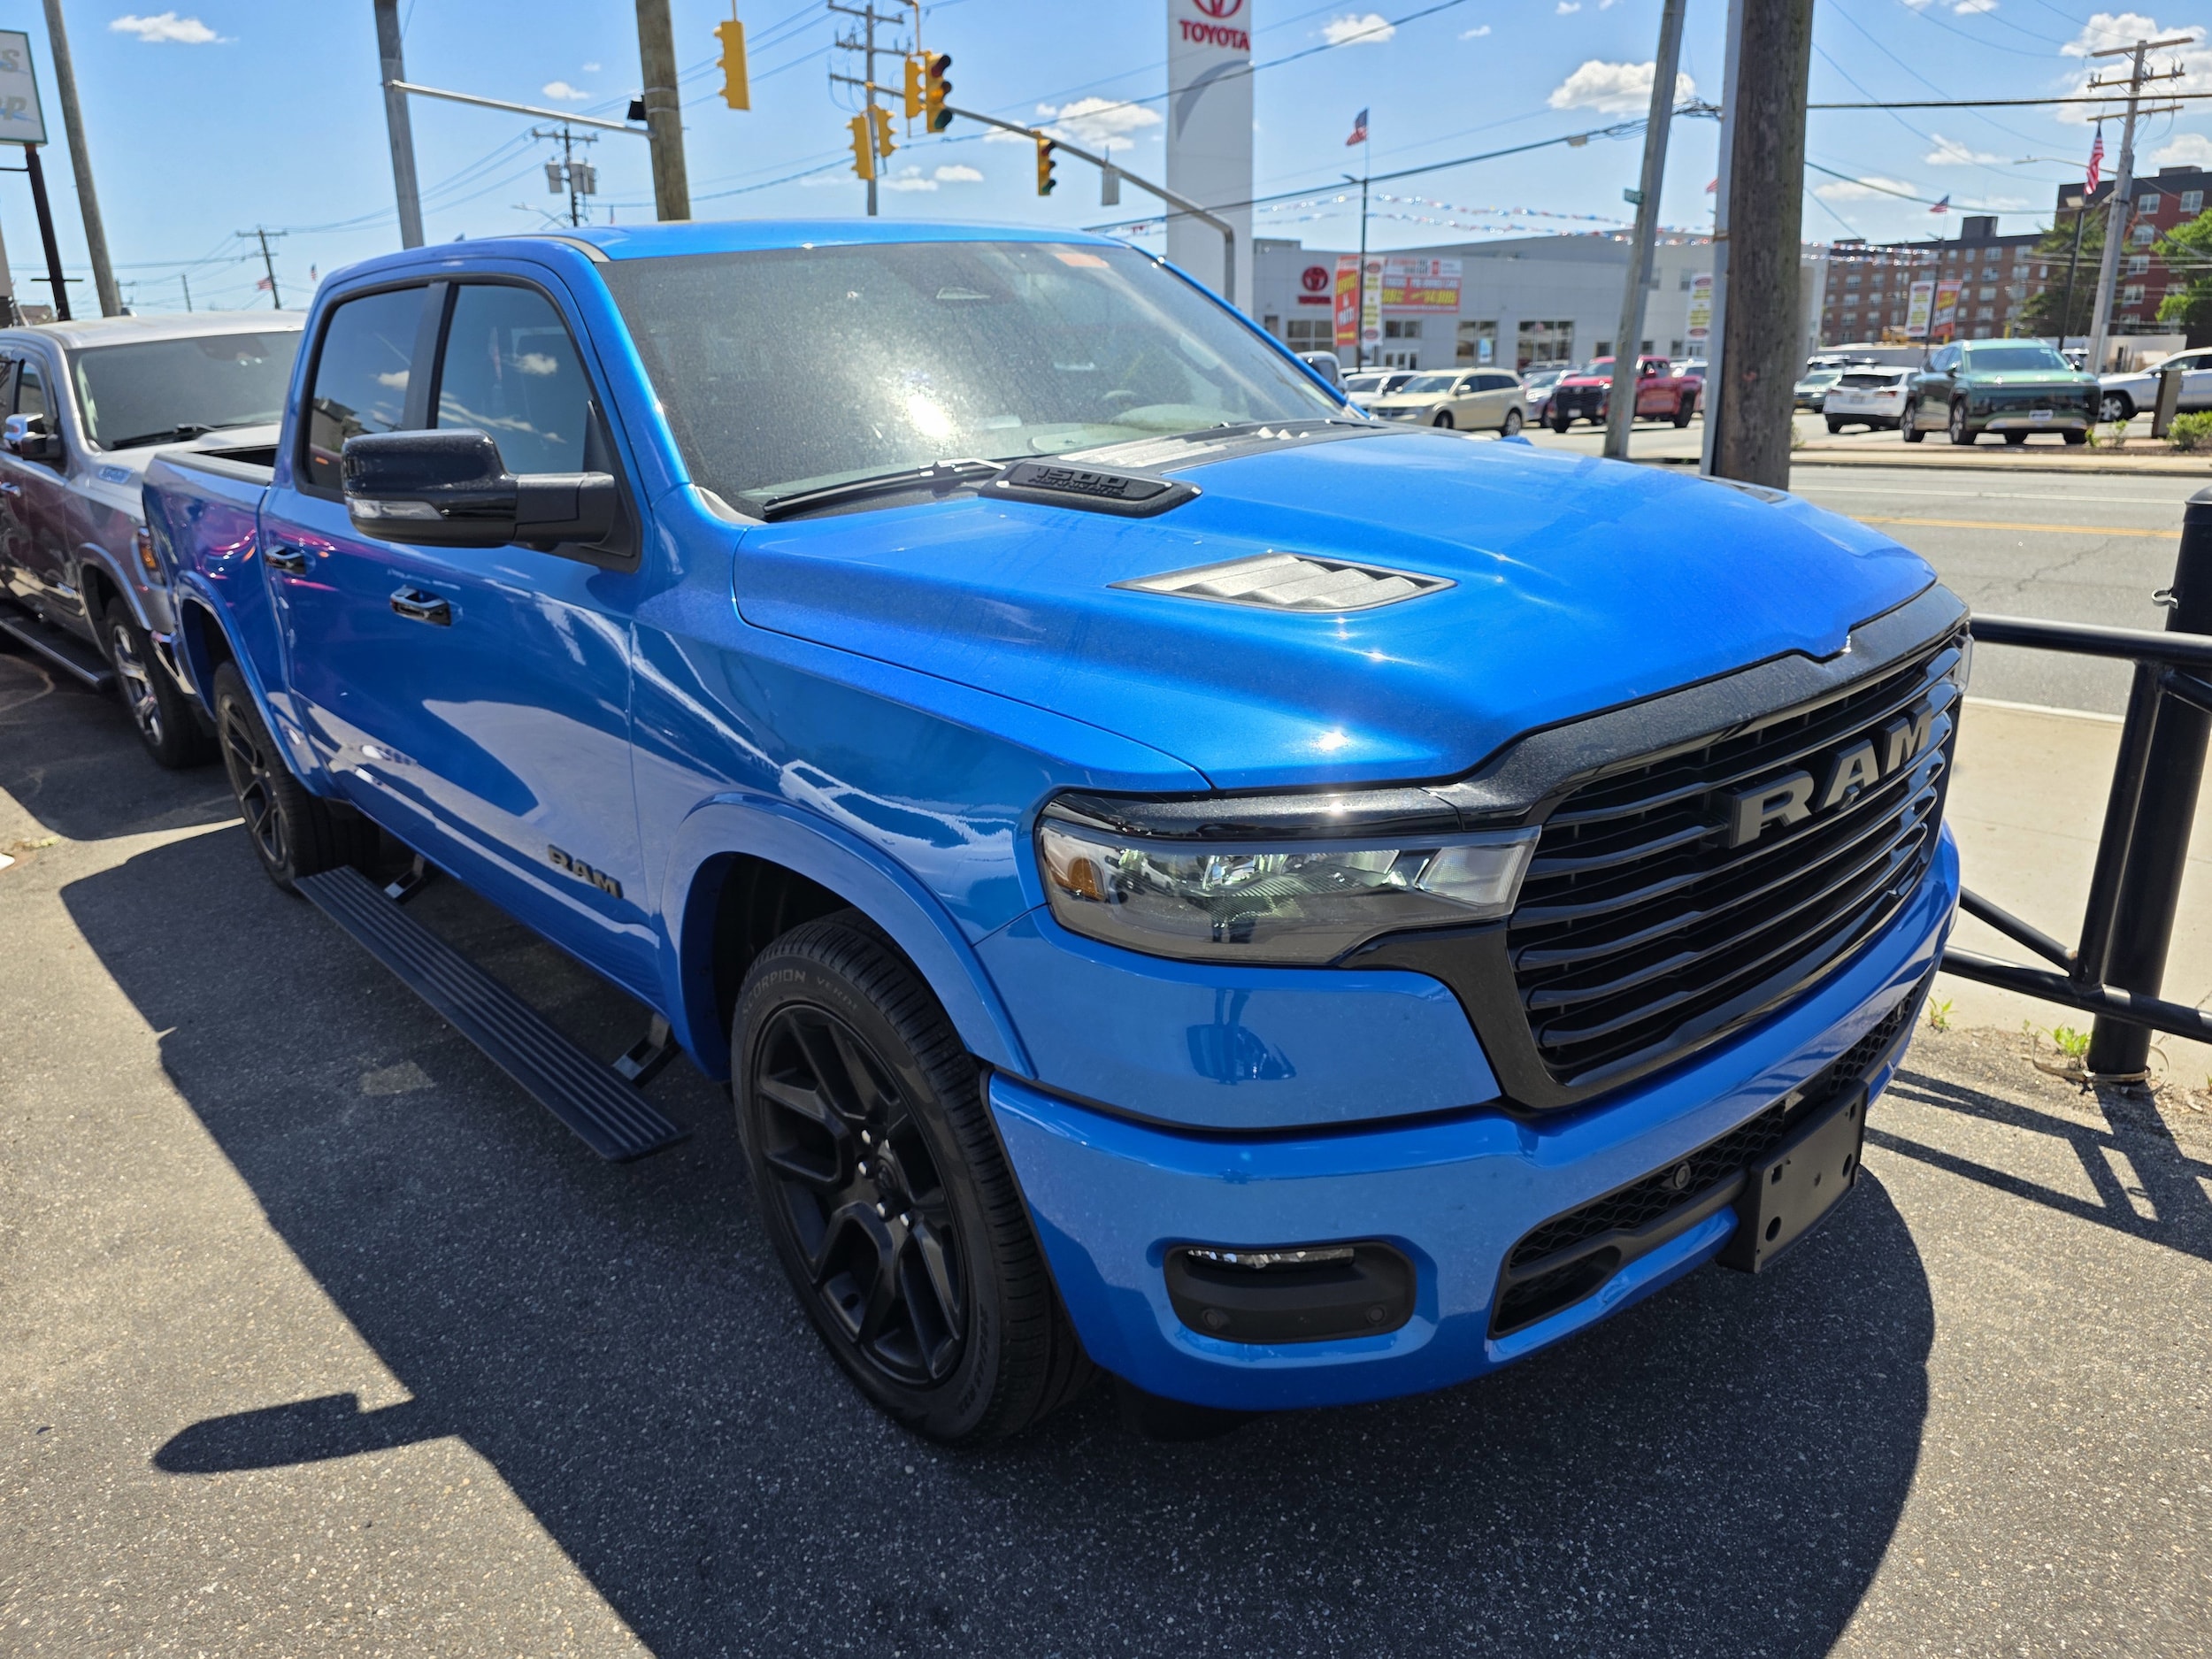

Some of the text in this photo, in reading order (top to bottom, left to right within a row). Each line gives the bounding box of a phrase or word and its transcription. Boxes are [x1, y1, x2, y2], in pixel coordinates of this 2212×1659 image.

[1179, 19, 1250, 51] TOYOTA
[1036, 468, 1129, 489] 1500
[1730, 700, 1933, 849] RAM
[548, 844, 624, 899] RAM
[741, 969, 807, 1020] SCORPION
